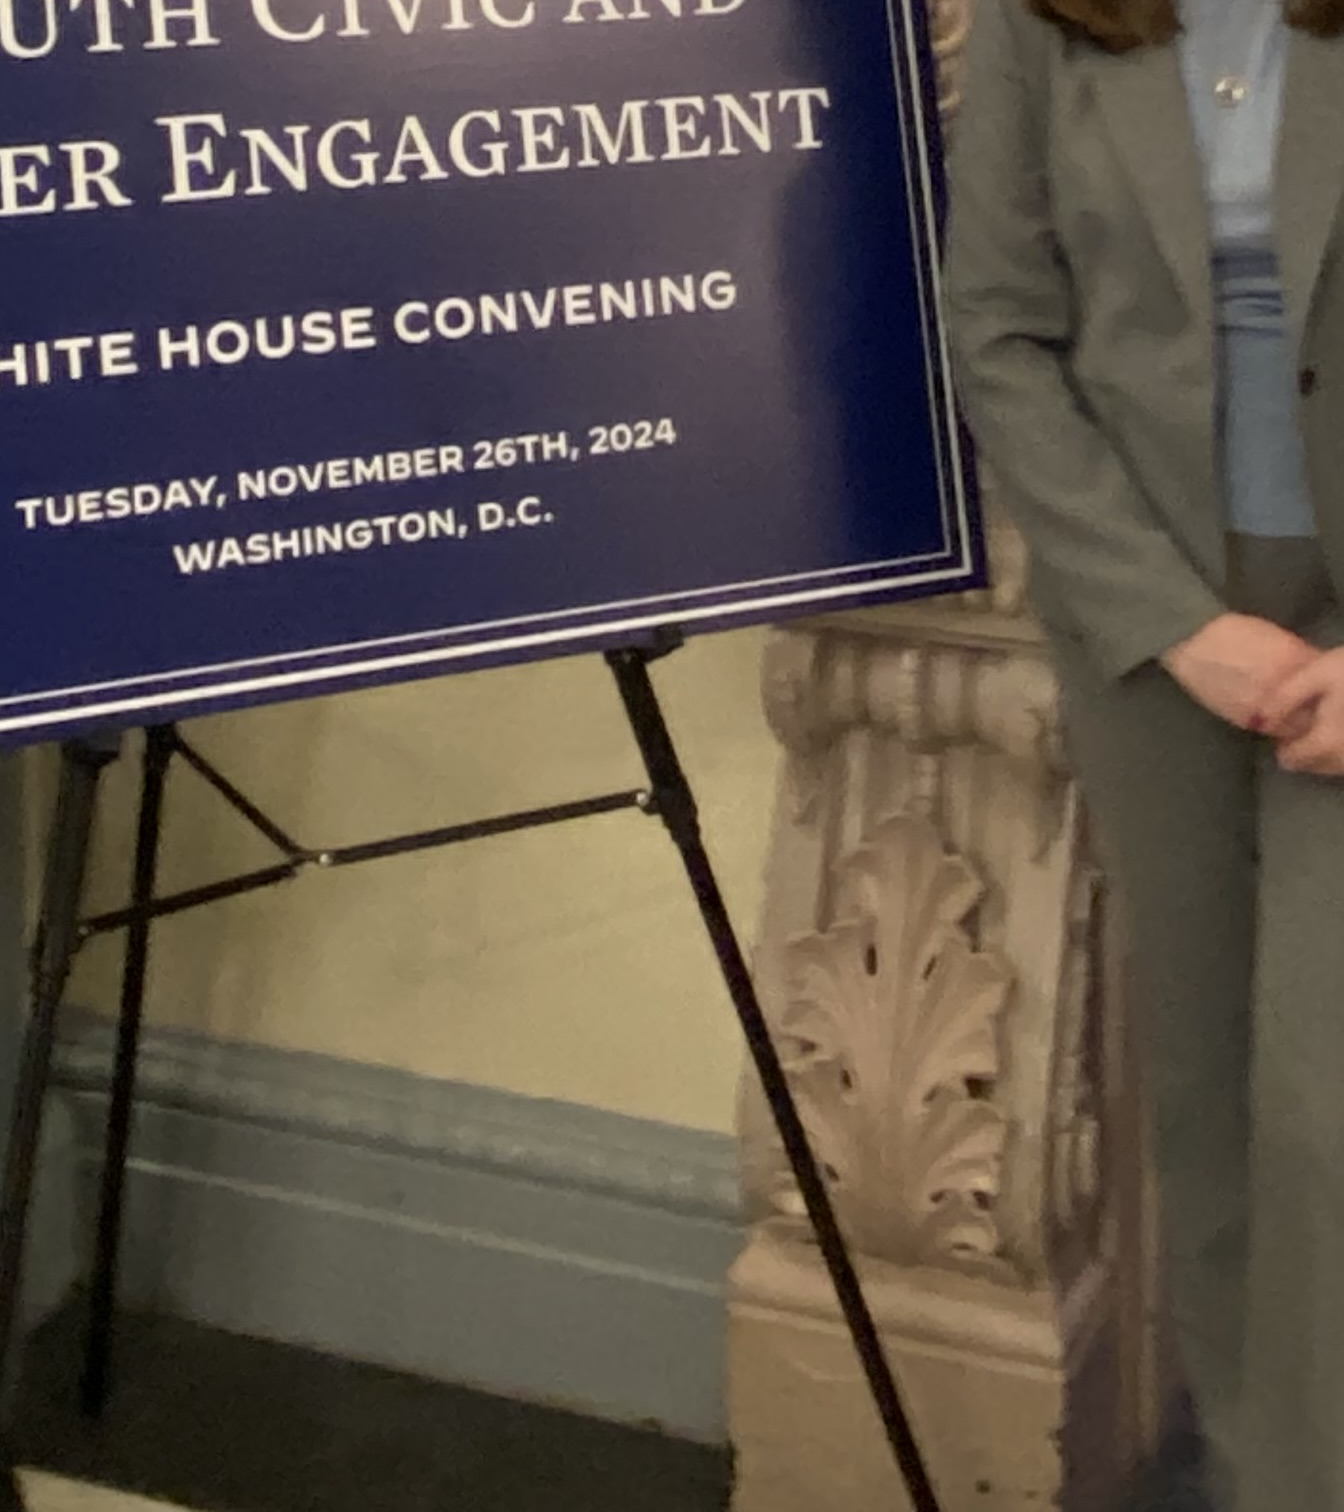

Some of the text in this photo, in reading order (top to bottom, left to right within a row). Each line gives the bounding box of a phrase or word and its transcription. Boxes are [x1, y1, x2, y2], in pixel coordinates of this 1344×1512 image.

[154, 86, 831, 203] ENGAGEMENT
[158, 306, 377, 371] HOUSE
[393, 270, 737, 344] CONVENING
[14, 418, 677, 529] TUESDAY, NOVEMBER 26TH, 2024
[172, 496, 554, 575] WASHINGTON, D.C.
